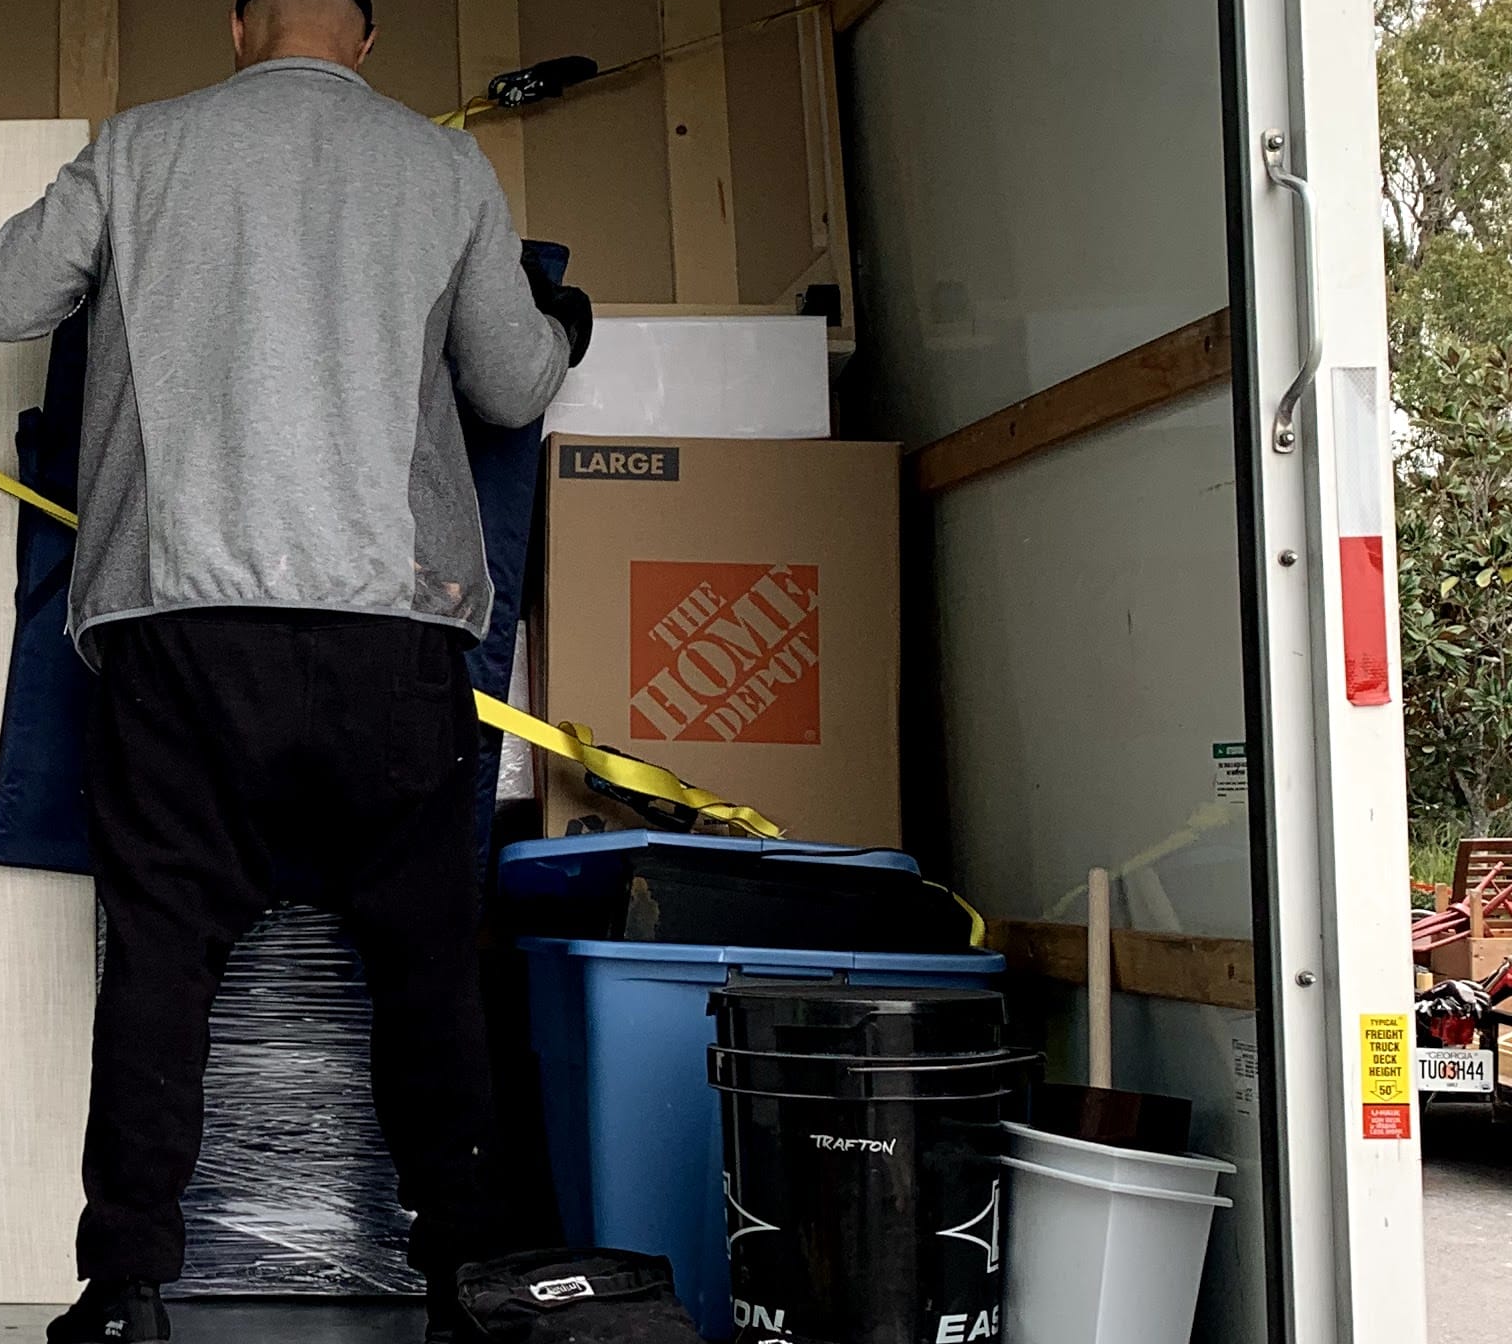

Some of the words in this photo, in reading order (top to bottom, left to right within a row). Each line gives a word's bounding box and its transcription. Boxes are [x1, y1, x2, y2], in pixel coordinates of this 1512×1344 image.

[574, 451, 665, 476] LARGE
[649, 582, 728, 653] THE
[630, 563, 820, 742] HOME
[704, 633, 820, 743] DEPOT
[1370, 1019, 1398, 1027] TYPICAL
[1365, 1029, 1404, 1040] FREIGHT
[1370, 1042, 1400, 1052] TRUCK
[1373, 1054, 1398, 1064] DECK
[1429, 1051, 1473, 1060] GEORGIA
[1368, 1067, 1402, 1077] HEIGHT
[1419, 1060, 1484, 1081] TU03H44
[809, 1134, 897, 1156] TRAFTON
